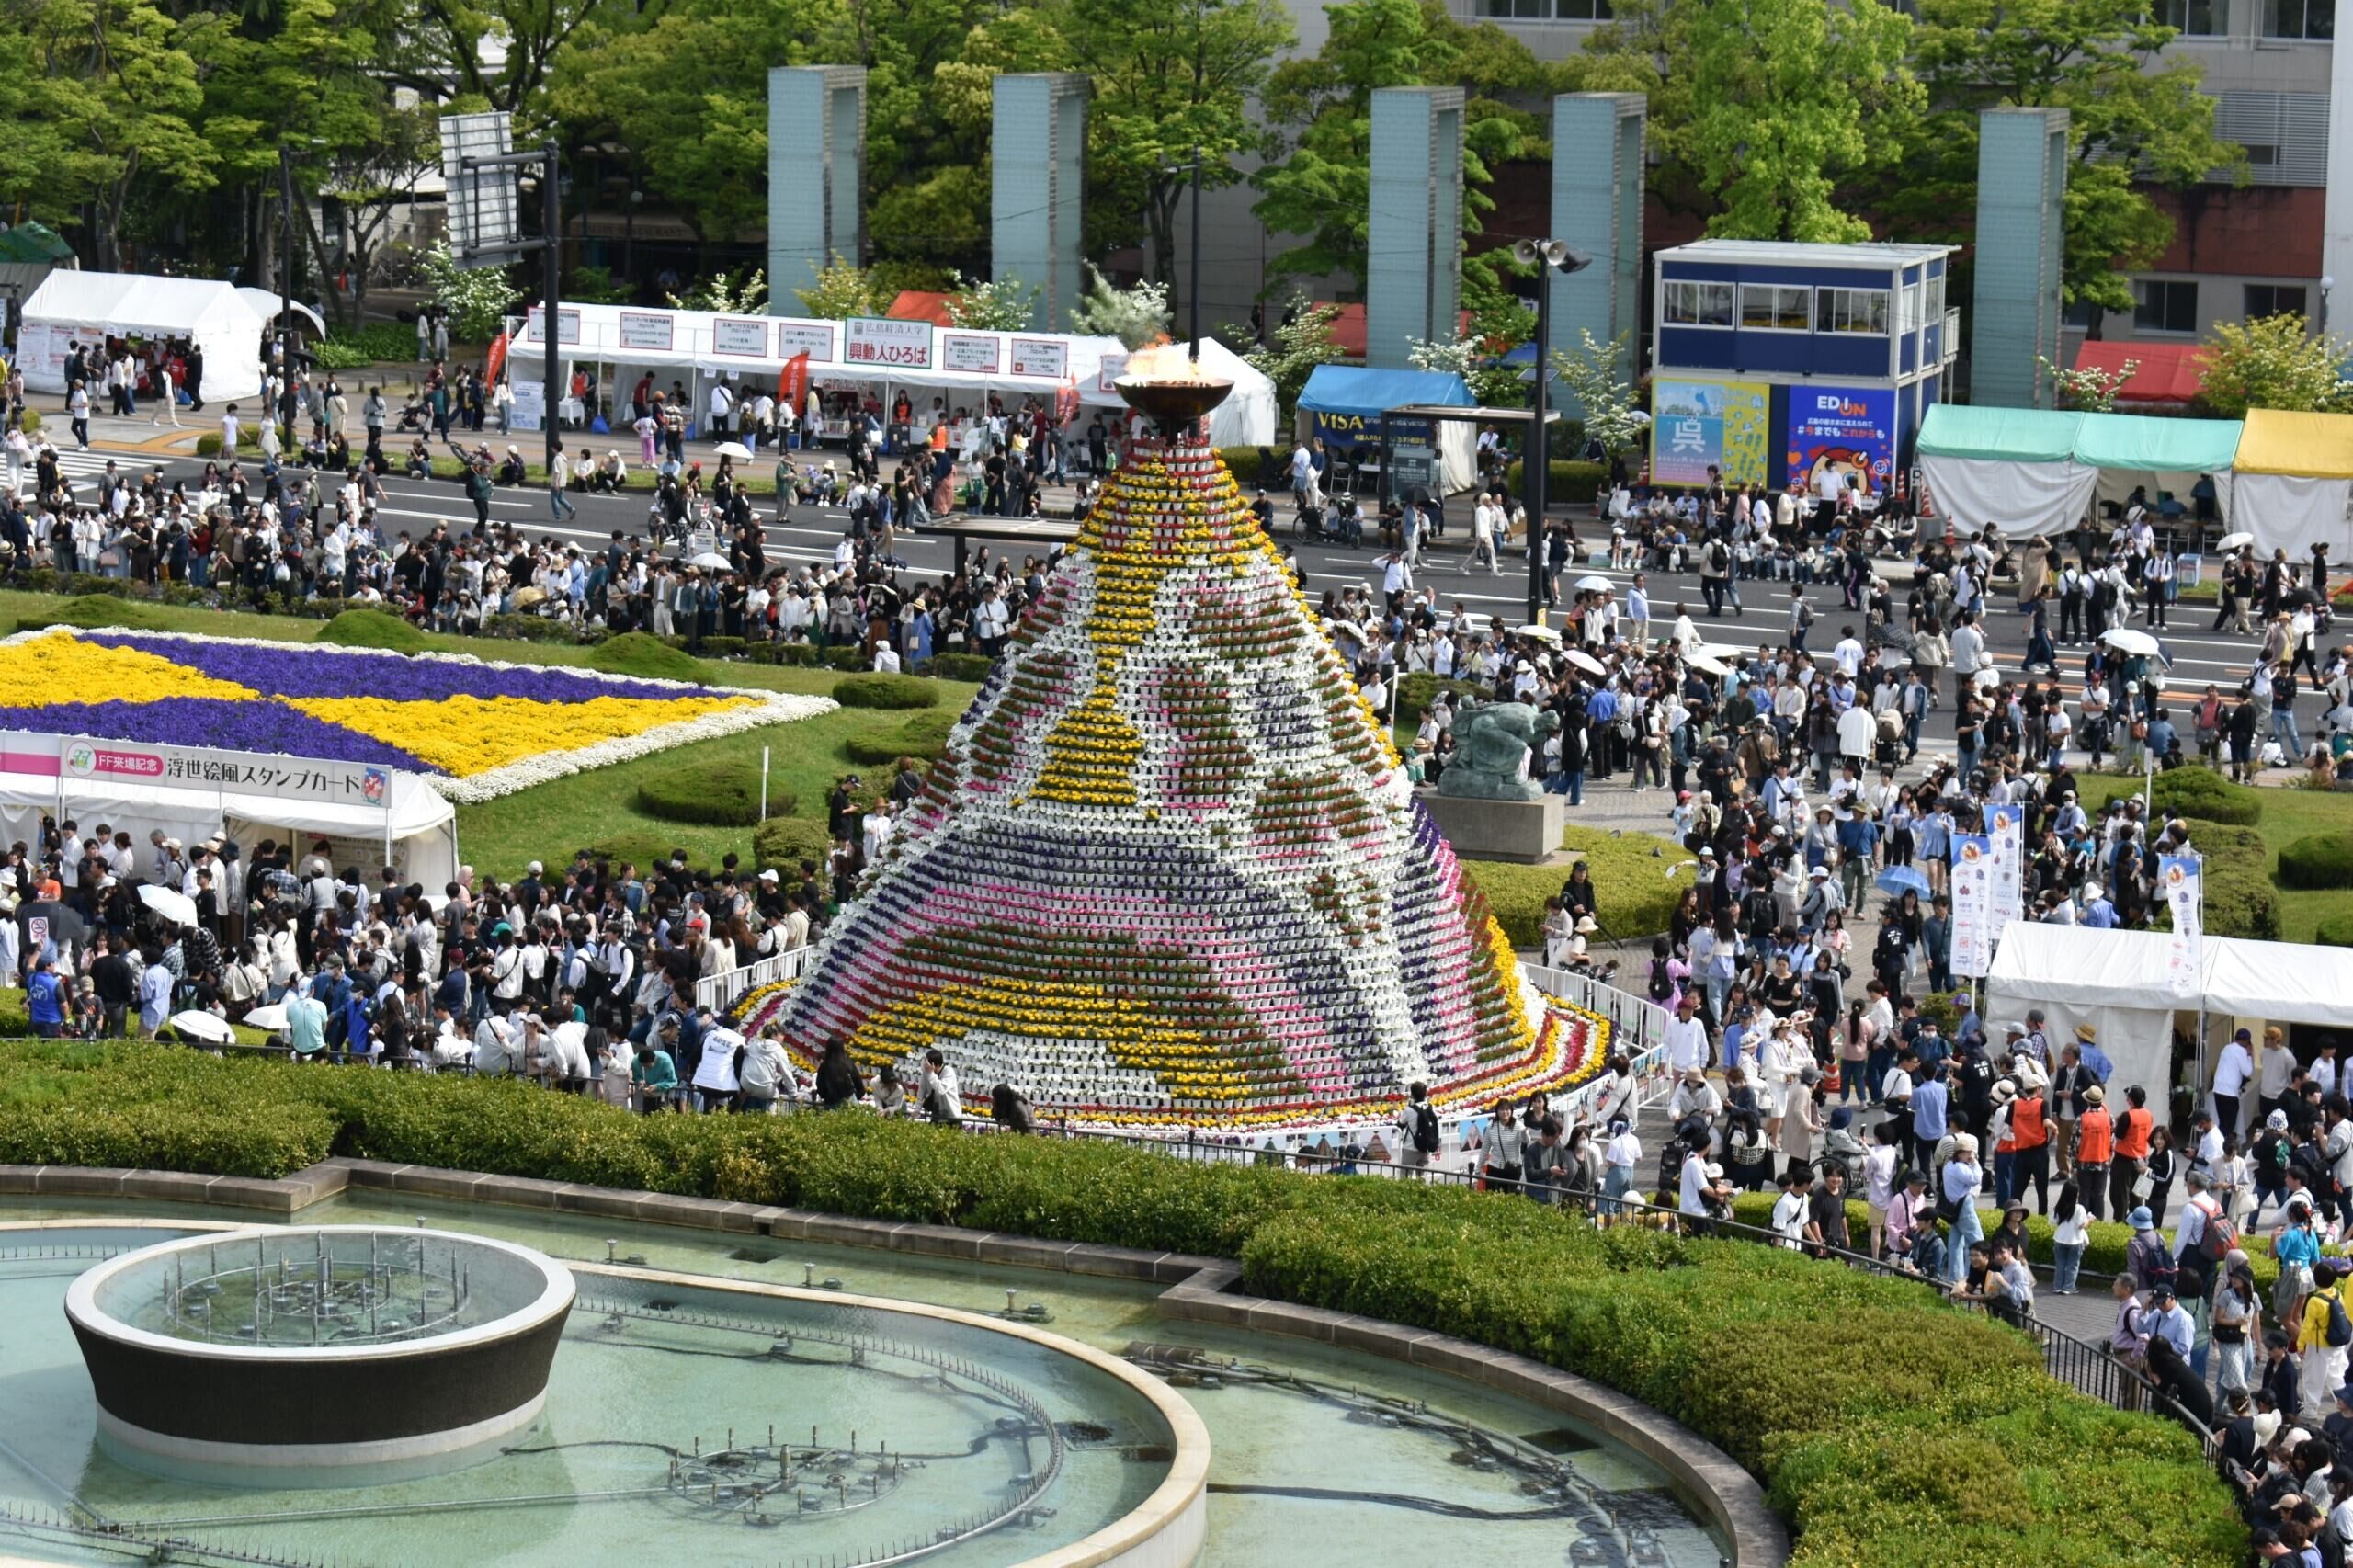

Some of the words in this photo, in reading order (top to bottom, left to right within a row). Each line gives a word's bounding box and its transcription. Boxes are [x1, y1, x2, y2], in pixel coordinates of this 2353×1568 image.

[866, 322, 925, 335] 広島経済大学
[849, 341, 927, 364] 興動人ひろば
[1817, 395, 1867, 416] EDION
[1317, 412, 1364, 430] VISA
[1671, 419, 1707, 454] 呉
[1798, 425, 1885, 439] #今までもこれからも
[98, 755, 158, 772] FF来場記念
[167, 757, 360, 794] 浮世絵風スタンプカード
